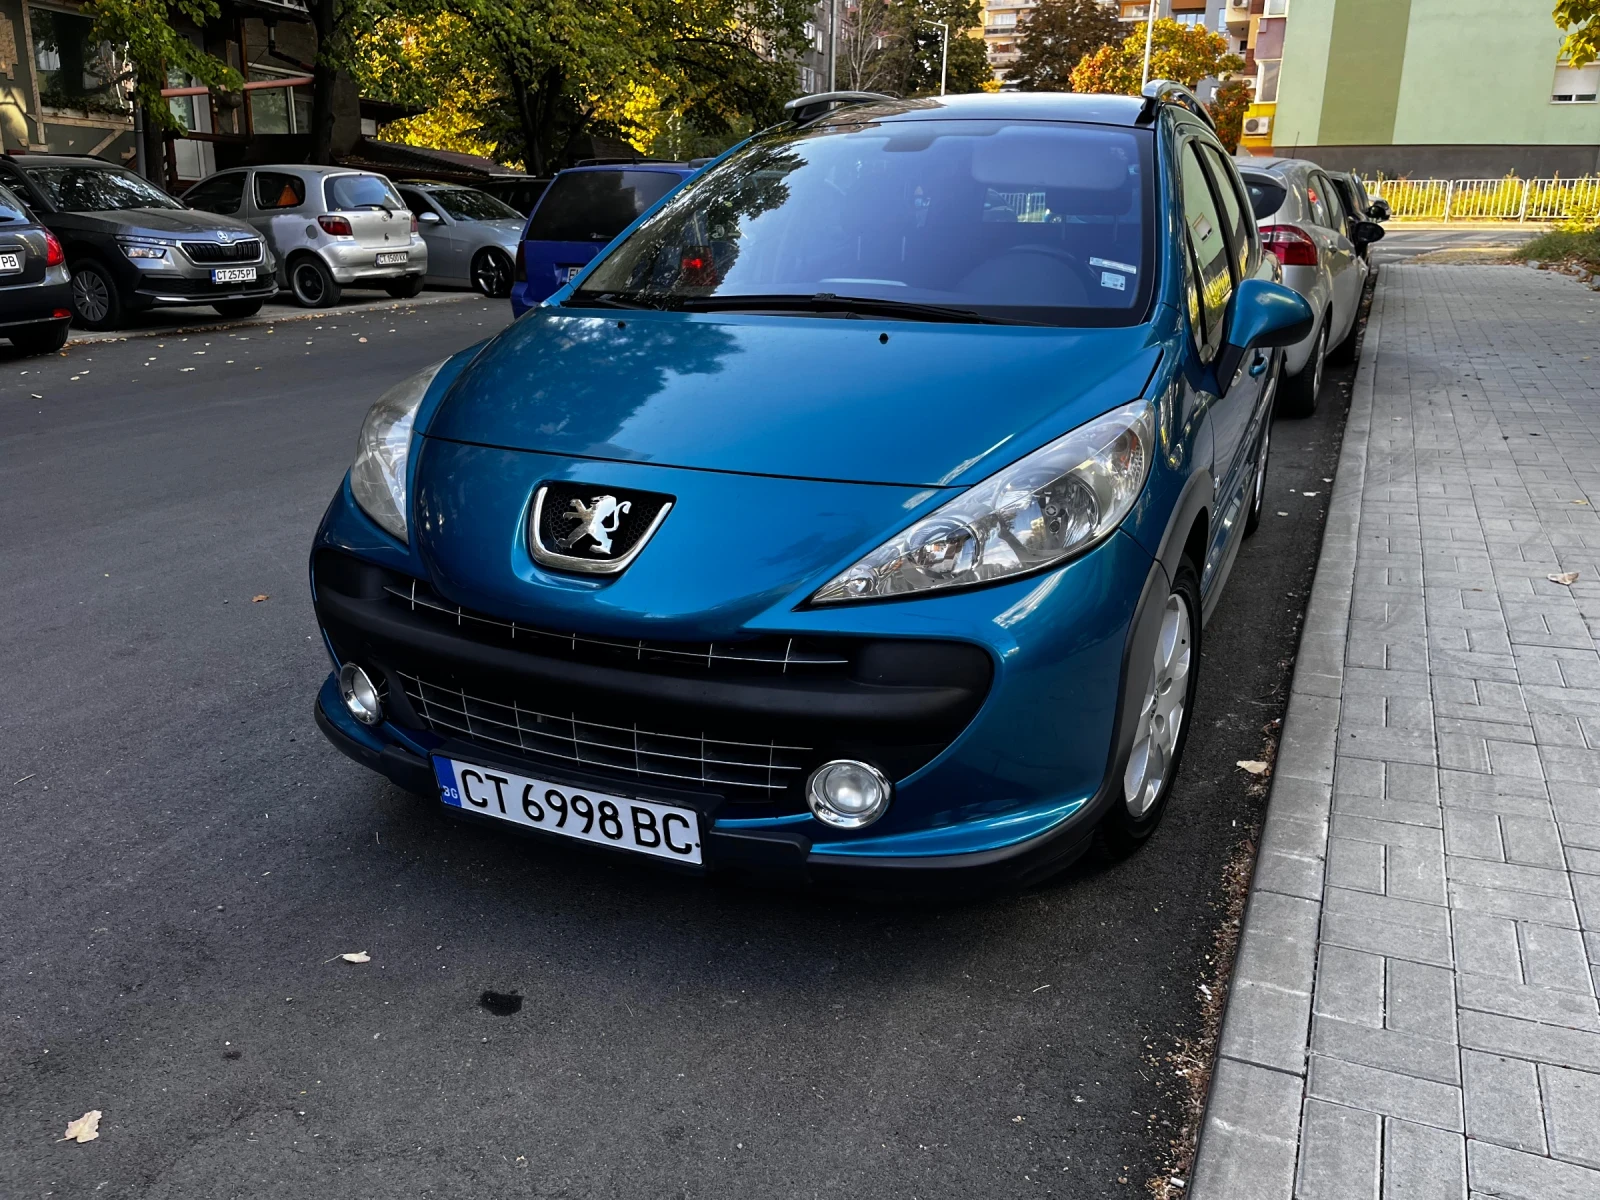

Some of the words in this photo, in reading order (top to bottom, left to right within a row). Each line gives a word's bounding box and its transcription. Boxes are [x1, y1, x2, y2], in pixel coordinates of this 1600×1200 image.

[1, 256, 17, 267] PB
[217, 270, 227, 280] CT
[228, 269, 246, 280] 2575
[246, 268, 255, 278] PT
[461, 769, 509, 814] CT
[522, 783, 624, 841] 6998
[630, 805, 693, 855] BC
